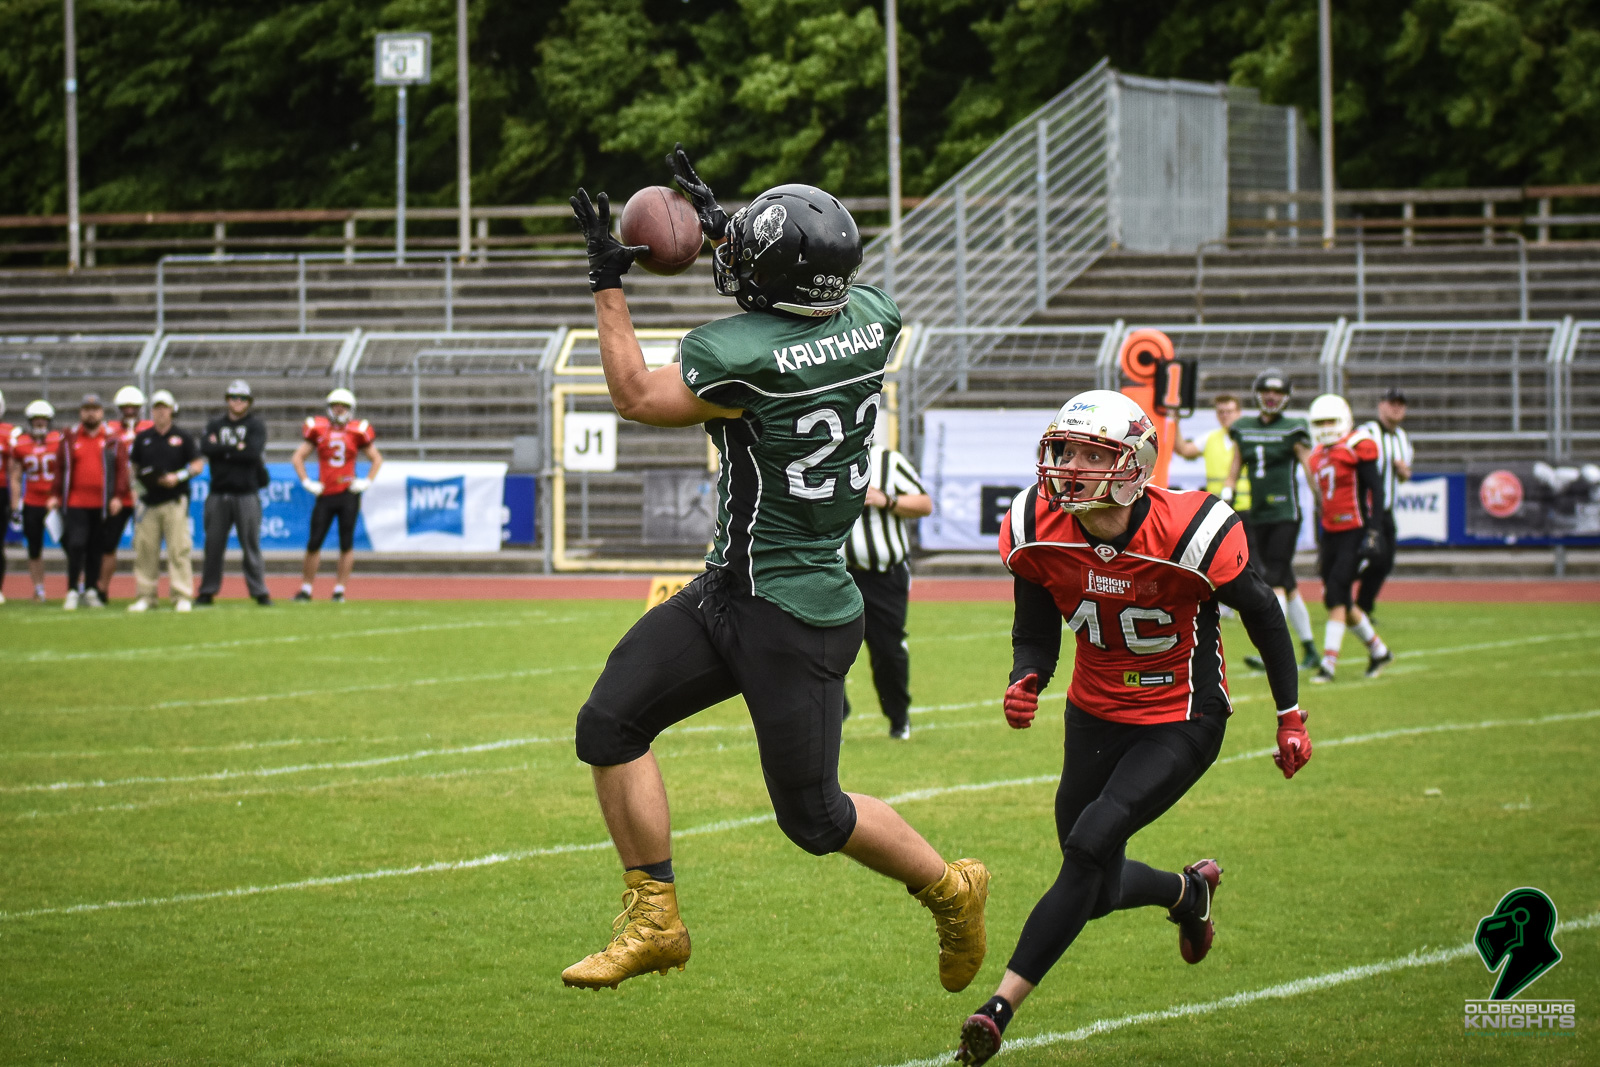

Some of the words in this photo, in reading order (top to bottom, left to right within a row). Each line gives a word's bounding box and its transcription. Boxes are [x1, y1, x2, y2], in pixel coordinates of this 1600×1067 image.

[773, 322, 885, 374] KRUTHAUP
[1163, 363, 1182, 407] 1
[328, 440, 346, 468] 3
[574, 429, 603, 455] J1
[785, 392, 882, 502] 23
[1254, 444, 1266, 479] 1
[410, 484, 460, 510] NWZ
[1095, 575, 1132, 589] BRIGHT
[1096, 584, 1125, 595] SKIES
